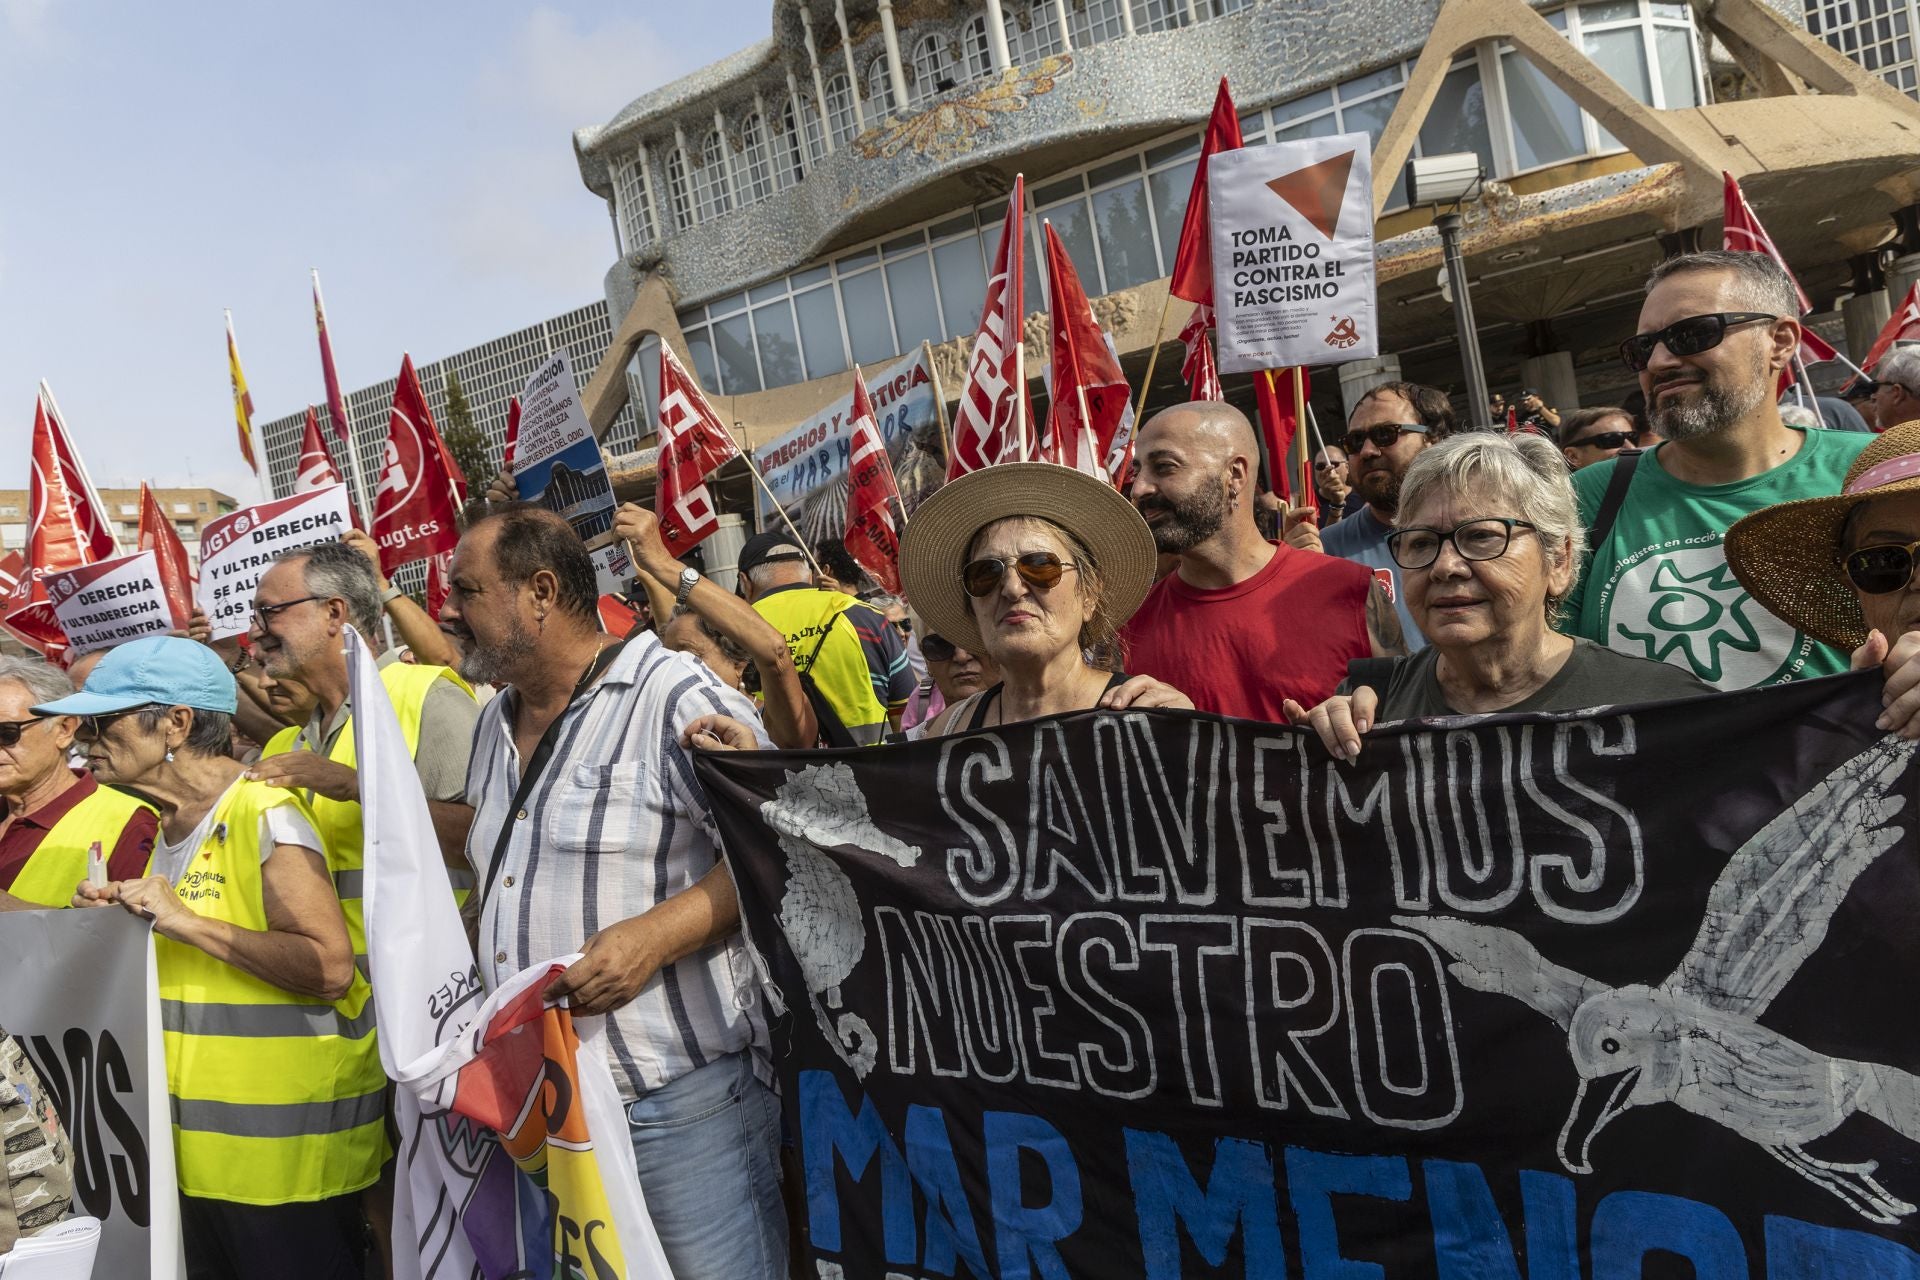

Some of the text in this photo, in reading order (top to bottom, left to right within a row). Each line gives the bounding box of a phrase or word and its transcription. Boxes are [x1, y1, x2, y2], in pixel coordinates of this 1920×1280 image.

[1231, 225, 1292, 248] TOMA
[1232, 242, 1320, 268] PARTIDO
[1233, 260, 1345, 288] CONTRA EL
[1234, 281, 1339, 308] FASCISMO
[1329, 338, 1356, 349] PCE
[543, 397, 573, 418] HUMANOS
[831, 412, 842, 434] Y
[845, 363, 930, 426] JSTICIA
[532, 412, 570, 438] NATURALEZA
[525, 428, 561, 454] CONTRA LOS
[555, 438, 568, 452] DEL
[568, 428, 584, 443] ODIO
[791, 449, 832, 495] MAR
[252, 511, 343, 544] DERECHA
[1664, 538, 1681, 547] en
[1684, 531, 1716, 545] acció
[201, 525, 232, 560] UGT
[211, 568, 220, 580] Y
[78, 578, 155, 606] DERECHA
[213, 585, 231, 600] SE
[68, 599, 160, 629] ULTRADERECHA
[215, 603, 244, 619] LOS
[71, 619, 167, 647] SE ALÍAN CONTRA
[1790, 658, 1805, 673] en
[190, 888, 221, 900] Murcia
[874, 905, 1464, 1130] NUESTRO
[799, 1069, 1084, 1280] MAR
